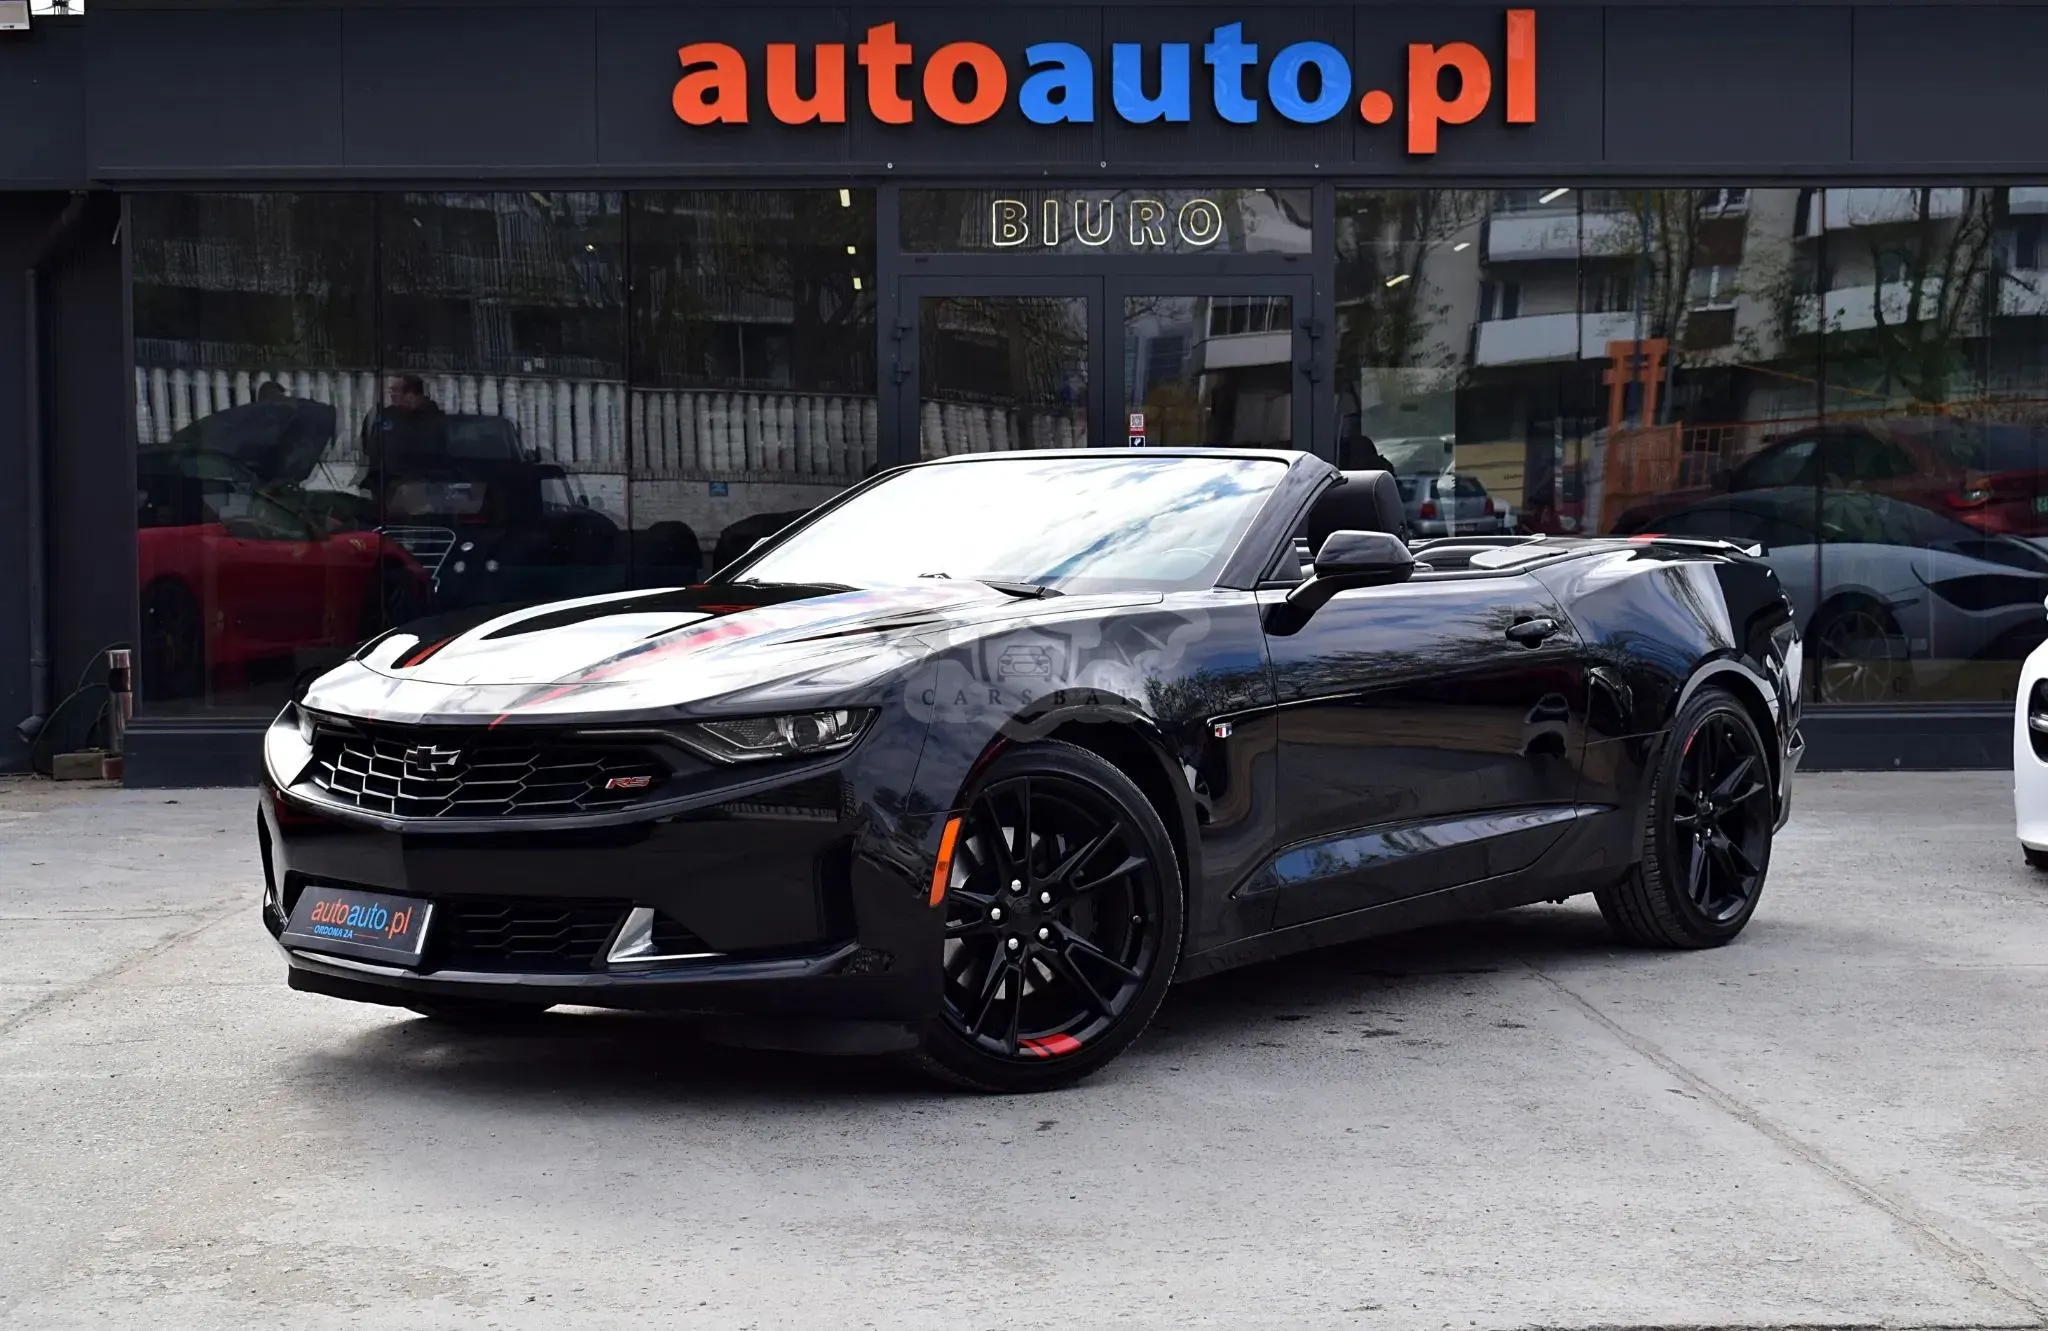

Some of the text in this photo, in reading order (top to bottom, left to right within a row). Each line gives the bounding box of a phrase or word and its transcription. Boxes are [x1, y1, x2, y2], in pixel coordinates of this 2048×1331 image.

[672, 10, 1536, 154] autoauto.pl
[992, 199, 1222, 246] BIURO
[605, 775, 652, 789] RS
[310, 898, 413, 940] autoauto.pl
